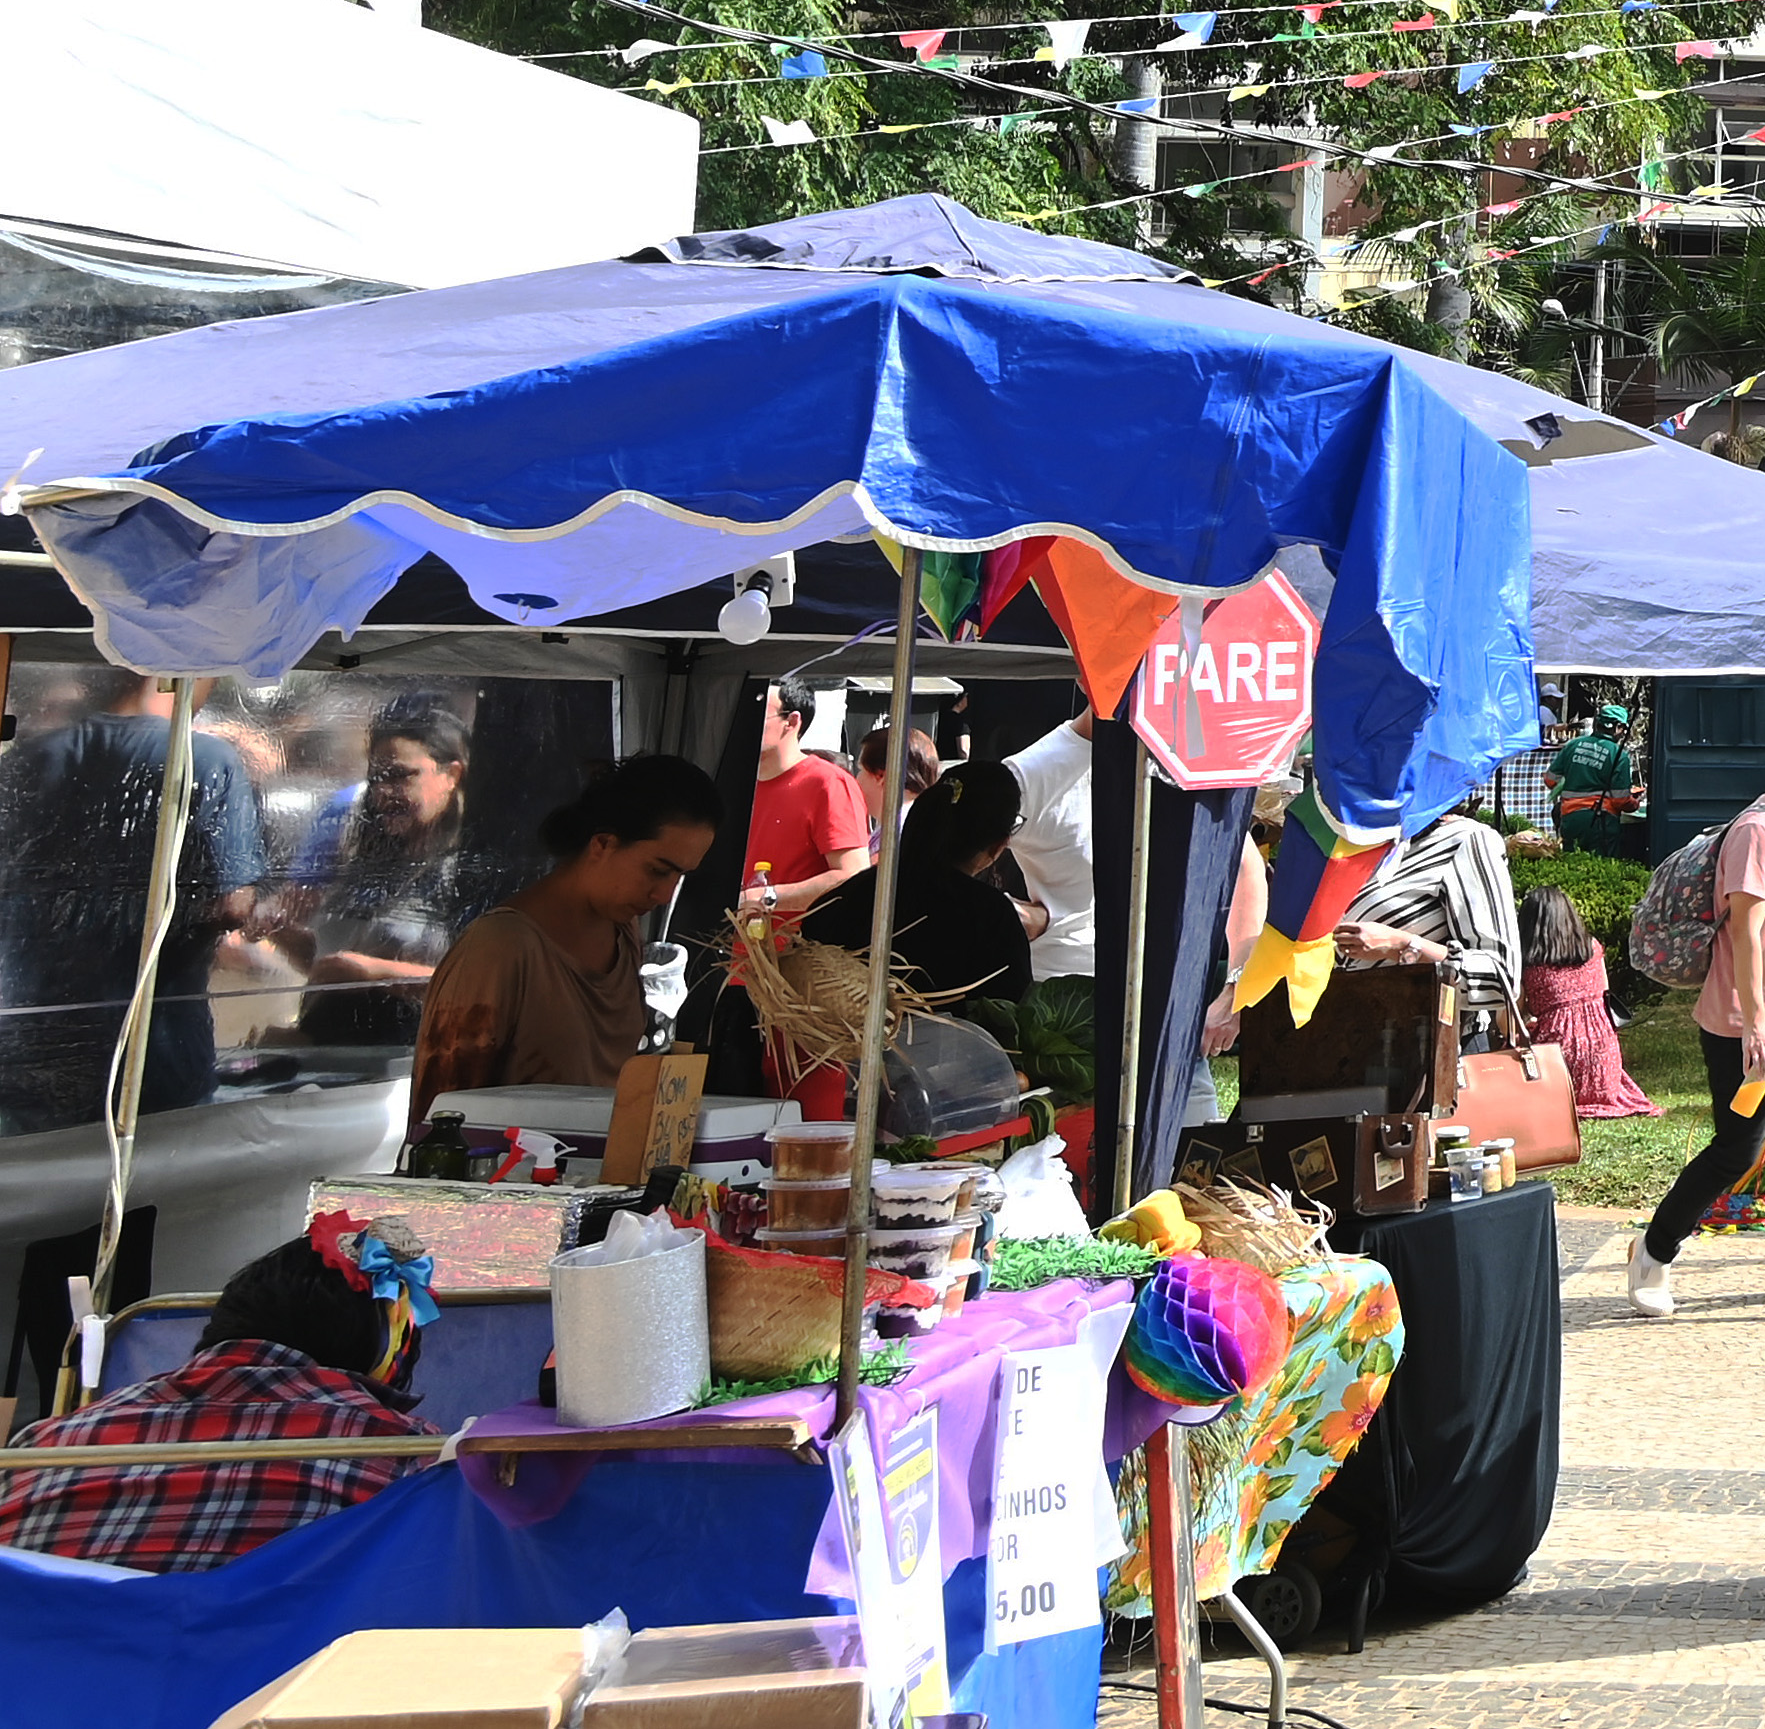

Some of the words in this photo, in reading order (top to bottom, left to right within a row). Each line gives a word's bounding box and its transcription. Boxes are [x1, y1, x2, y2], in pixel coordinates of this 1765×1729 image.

[1153, 641, 1298, 705] PARE
[1016, 1366, 1042, 1394] DE
[998, 1483, 1067, 1521] INHOS
